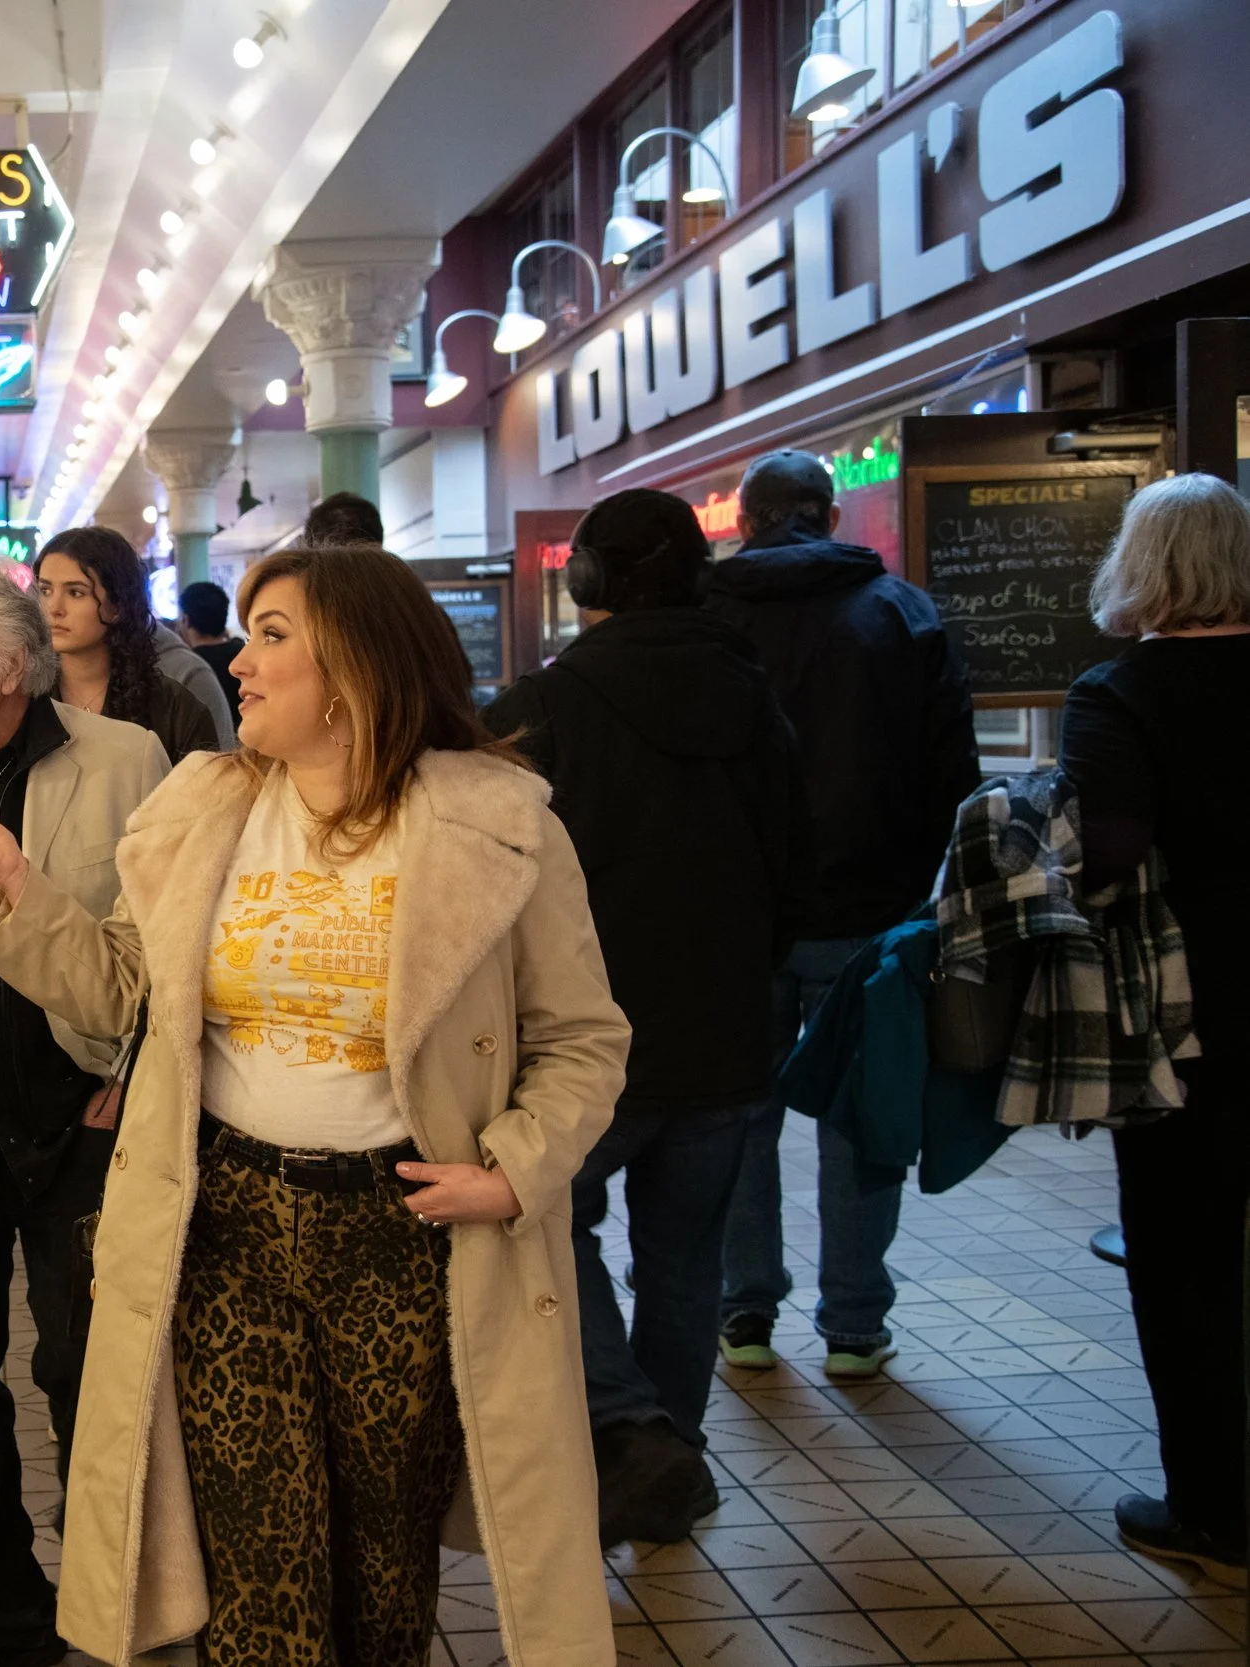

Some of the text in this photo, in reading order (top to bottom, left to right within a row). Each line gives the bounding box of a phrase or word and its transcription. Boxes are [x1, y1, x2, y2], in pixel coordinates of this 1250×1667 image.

[535, 10, 1126, 477] LOWELL'S
[969, 484, 1087, 507] SPECIALS
[936, 516, 1002, 542] CLAM
[991, 580, 1020, 608] of
[1023, 583, 1059, 609] the
[964, 622, 1057, 647] Seafood
[320, 914, 392, 934] PUBLIC
[291, 931, 378, 953] MARKET
[303, 952, 389, 975] CENTER
